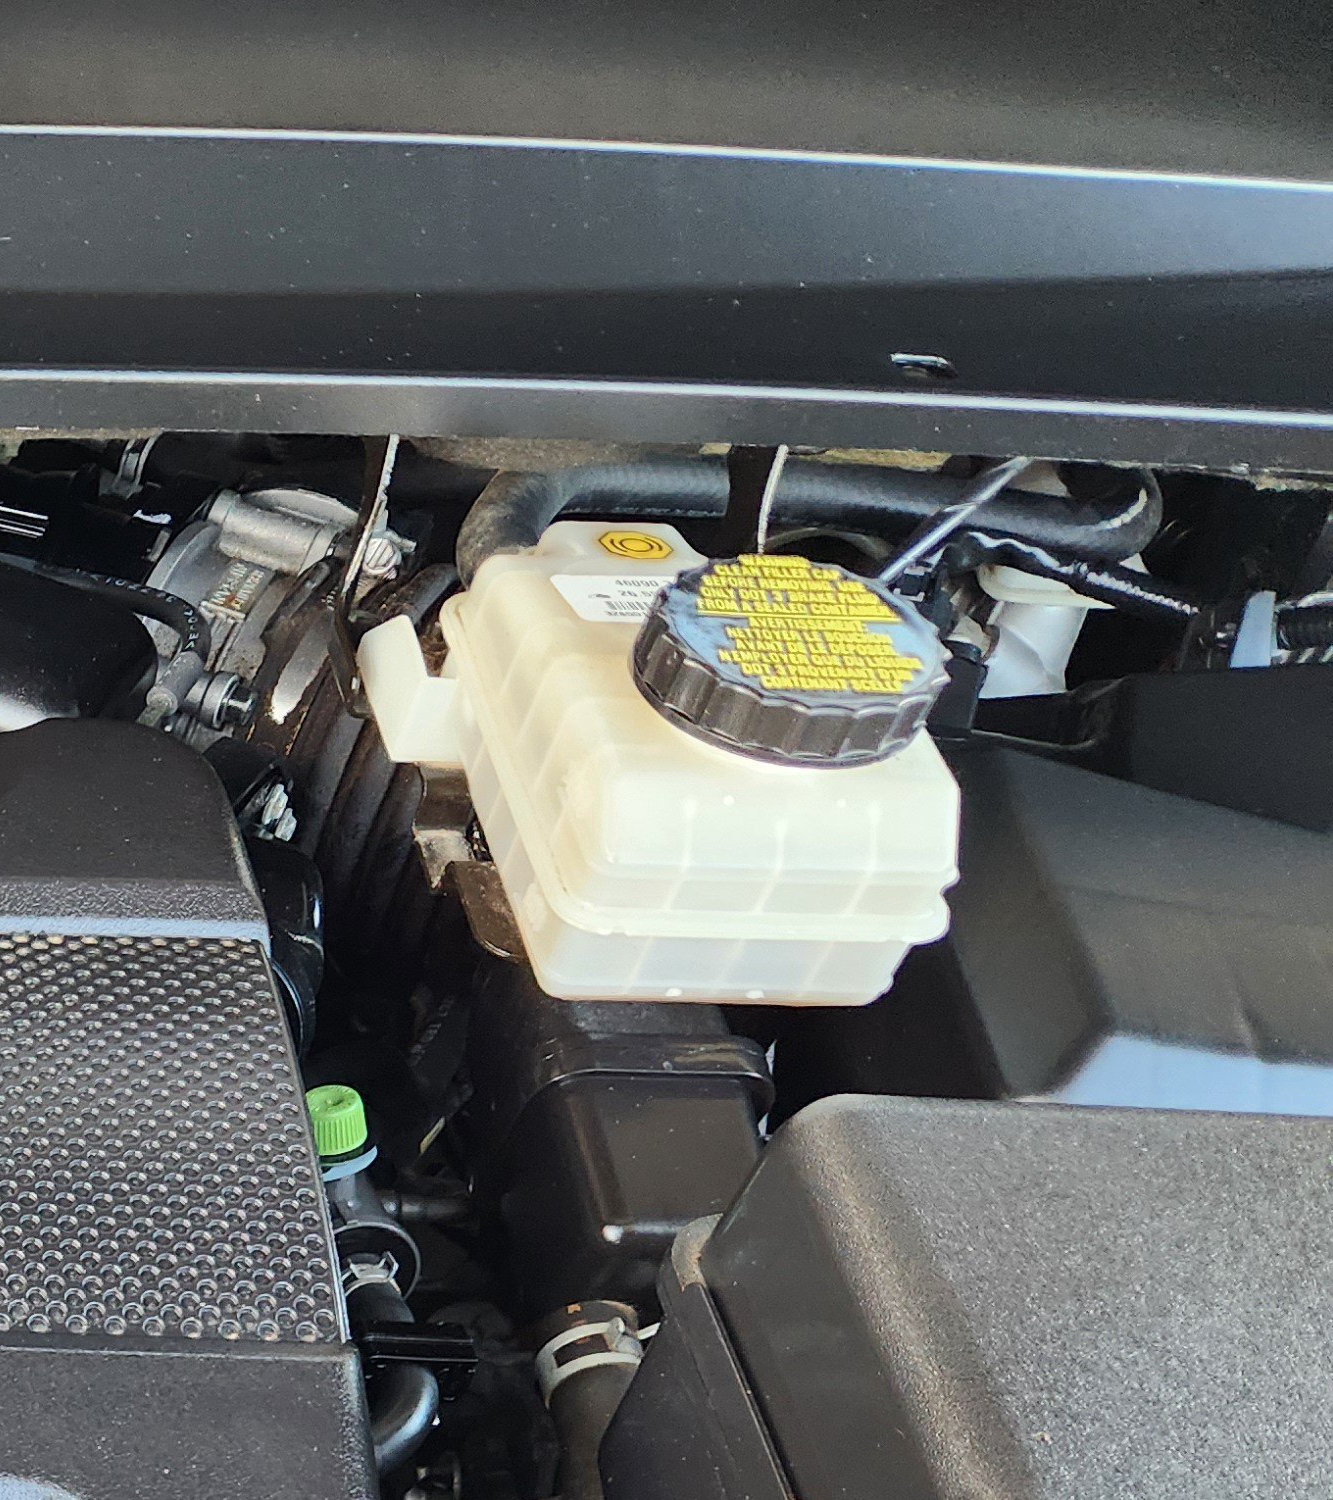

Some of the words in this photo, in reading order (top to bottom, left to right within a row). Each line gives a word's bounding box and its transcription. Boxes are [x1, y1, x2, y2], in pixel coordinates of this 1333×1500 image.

[713, 565, 761, 576] CLEAN
[763, 567, 810, 578] FILLER
[700, 575, 757, 588] BEFORE
[699, 586, 736, 598] ONLY
[738, 588, 767, 600] DOT
[772, 590, 783, 601] 3
[788, 591, 837, 603] BRAKE
[696, 596, 739, 611] FROM
[741, 600, 753, 612] A
[753, 602, 807, 613] SEALED
[725, 627, 801, 641] NETTOYER
[803, 632, 823, 642] LE
[736, 638, 783, 651] AVANT
[787, 642, 807, 653] DE
[808, 643, 828, 654] LE
[811, 654, 841, 666] QUE
[843, 656, 865, 667] DU
[741, 663, 770, 675] DOT
[775, 665, 786, 675] 3
[787, 665, 875, 679] PROVENANT
[760, 675, 848, 689] CONTENANT
